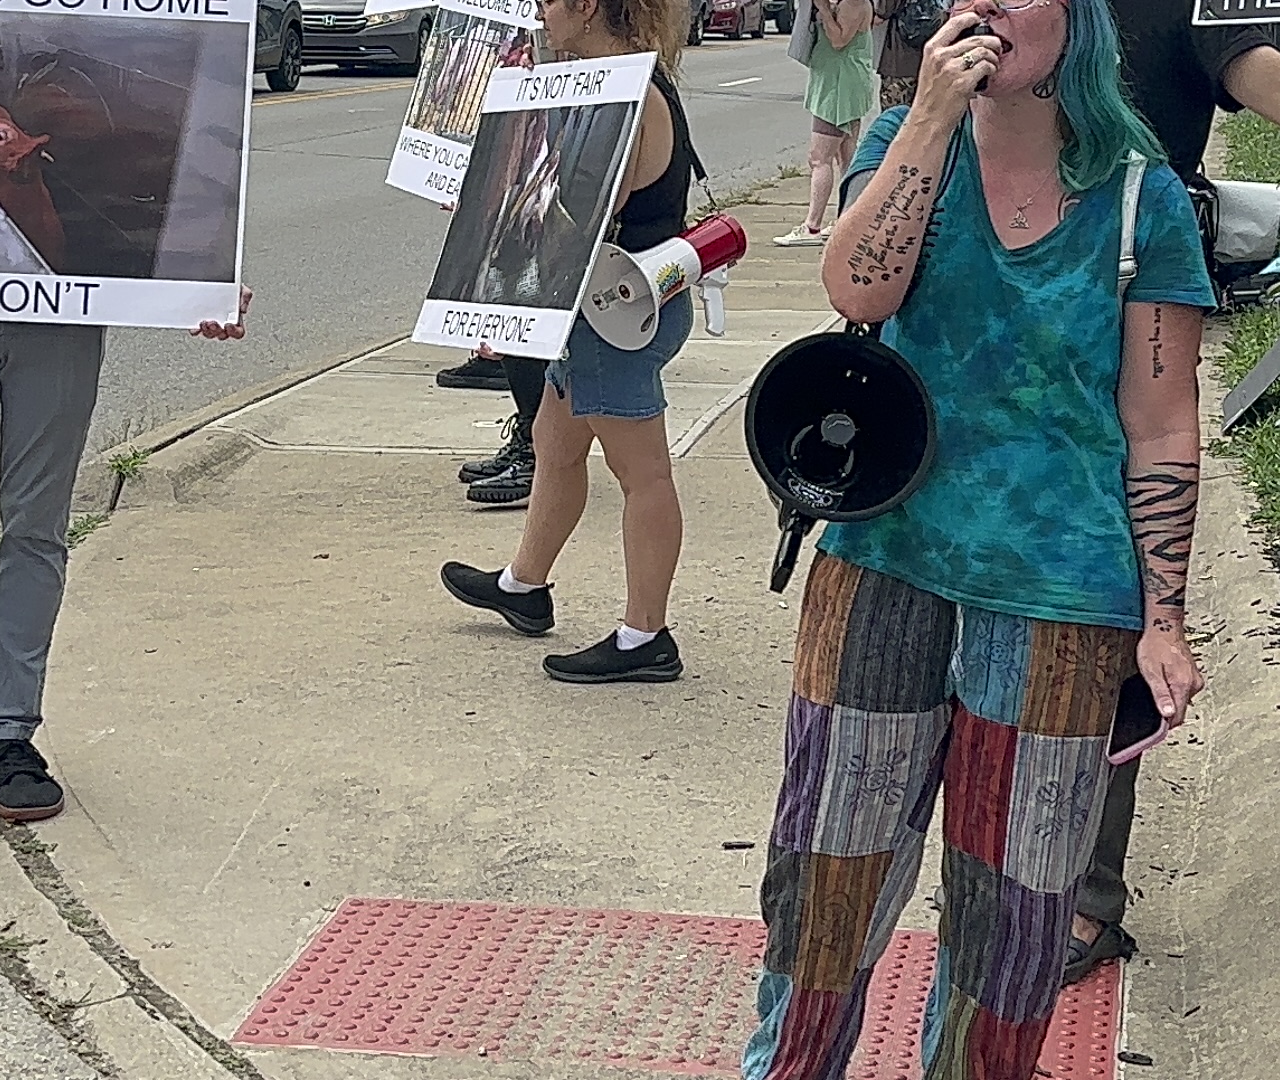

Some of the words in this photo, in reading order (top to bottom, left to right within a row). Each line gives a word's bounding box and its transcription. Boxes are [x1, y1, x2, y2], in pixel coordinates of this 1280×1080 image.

[539, 73, 571, 99] NOT
[399, 135, 432, 159] WHERE
[433, 146, 455, 166] YOU
[454, 153, 468, 170] CA
[425, 171, 447, 190] AND
[446, 177, 460, 197] EA
[847, 233, 876, 272] ANIMAL
[441, 310, 469, 336] FOR
[467, 313, 535, 343] EVERYONE
